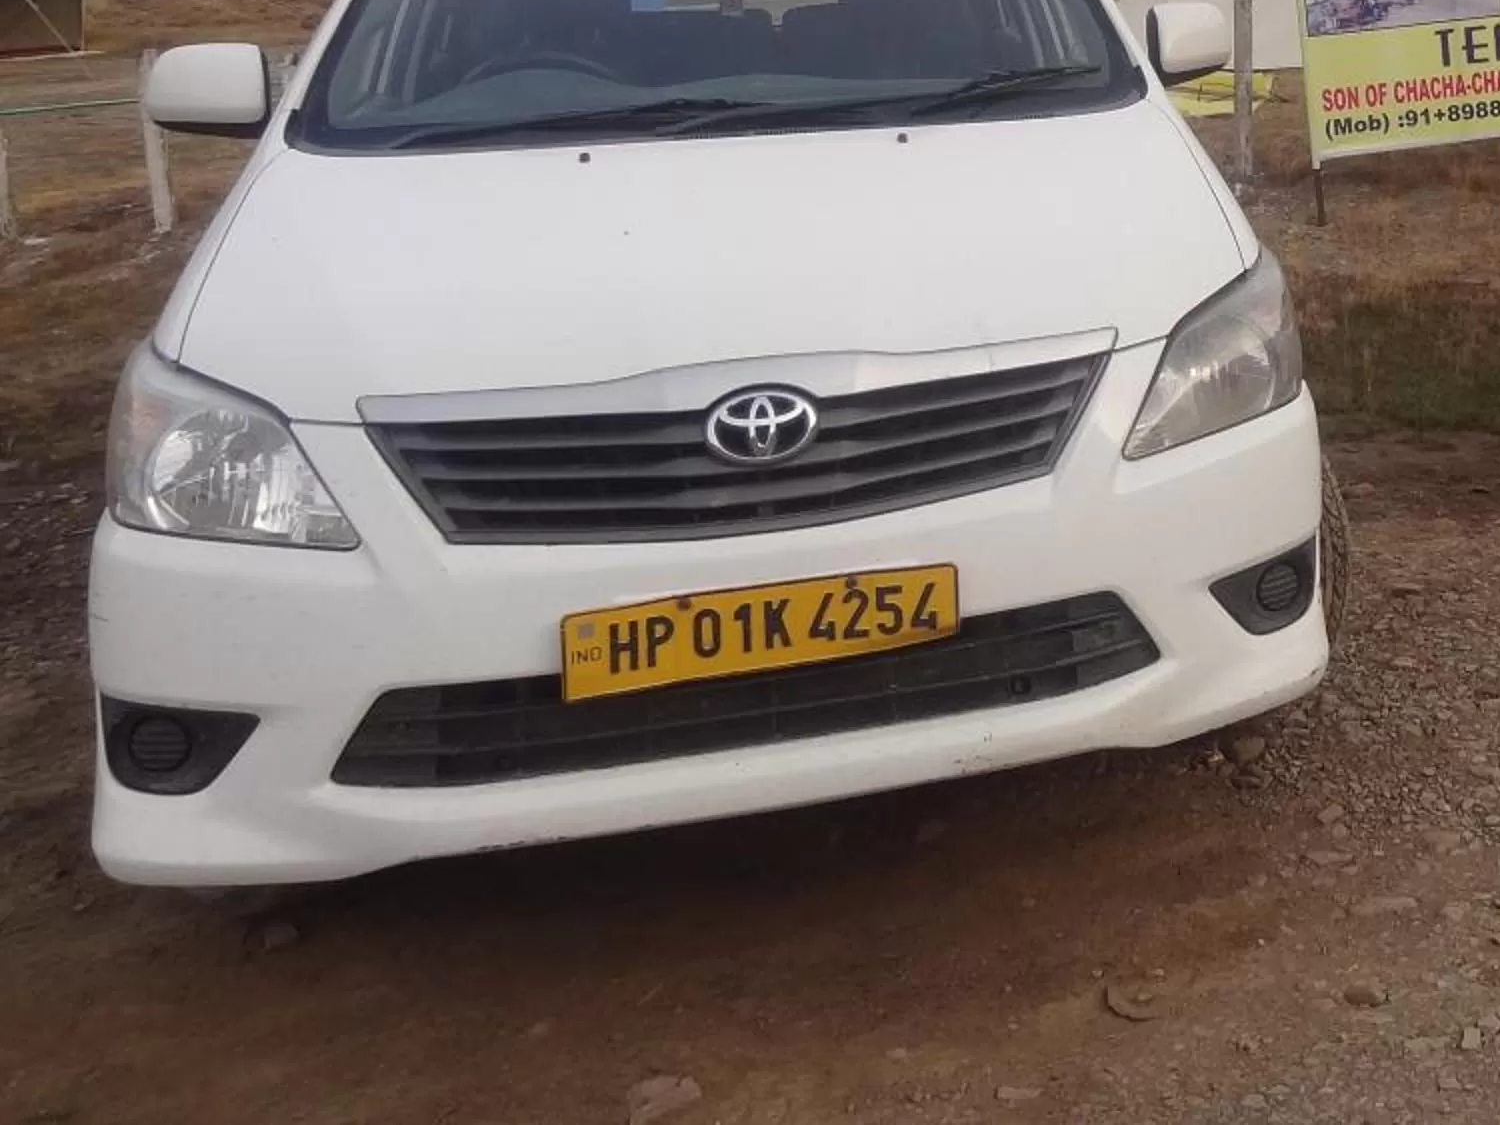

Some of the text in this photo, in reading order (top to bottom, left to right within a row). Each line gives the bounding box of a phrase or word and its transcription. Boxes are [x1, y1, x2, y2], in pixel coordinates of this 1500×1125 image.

[1321, 86, 1359, 112] SON
[1366, 83, 1388, 106] OF
[1325, 115, 1390, 142] (Mob)
[608, 581, 938, 674] HP 01K 4254
